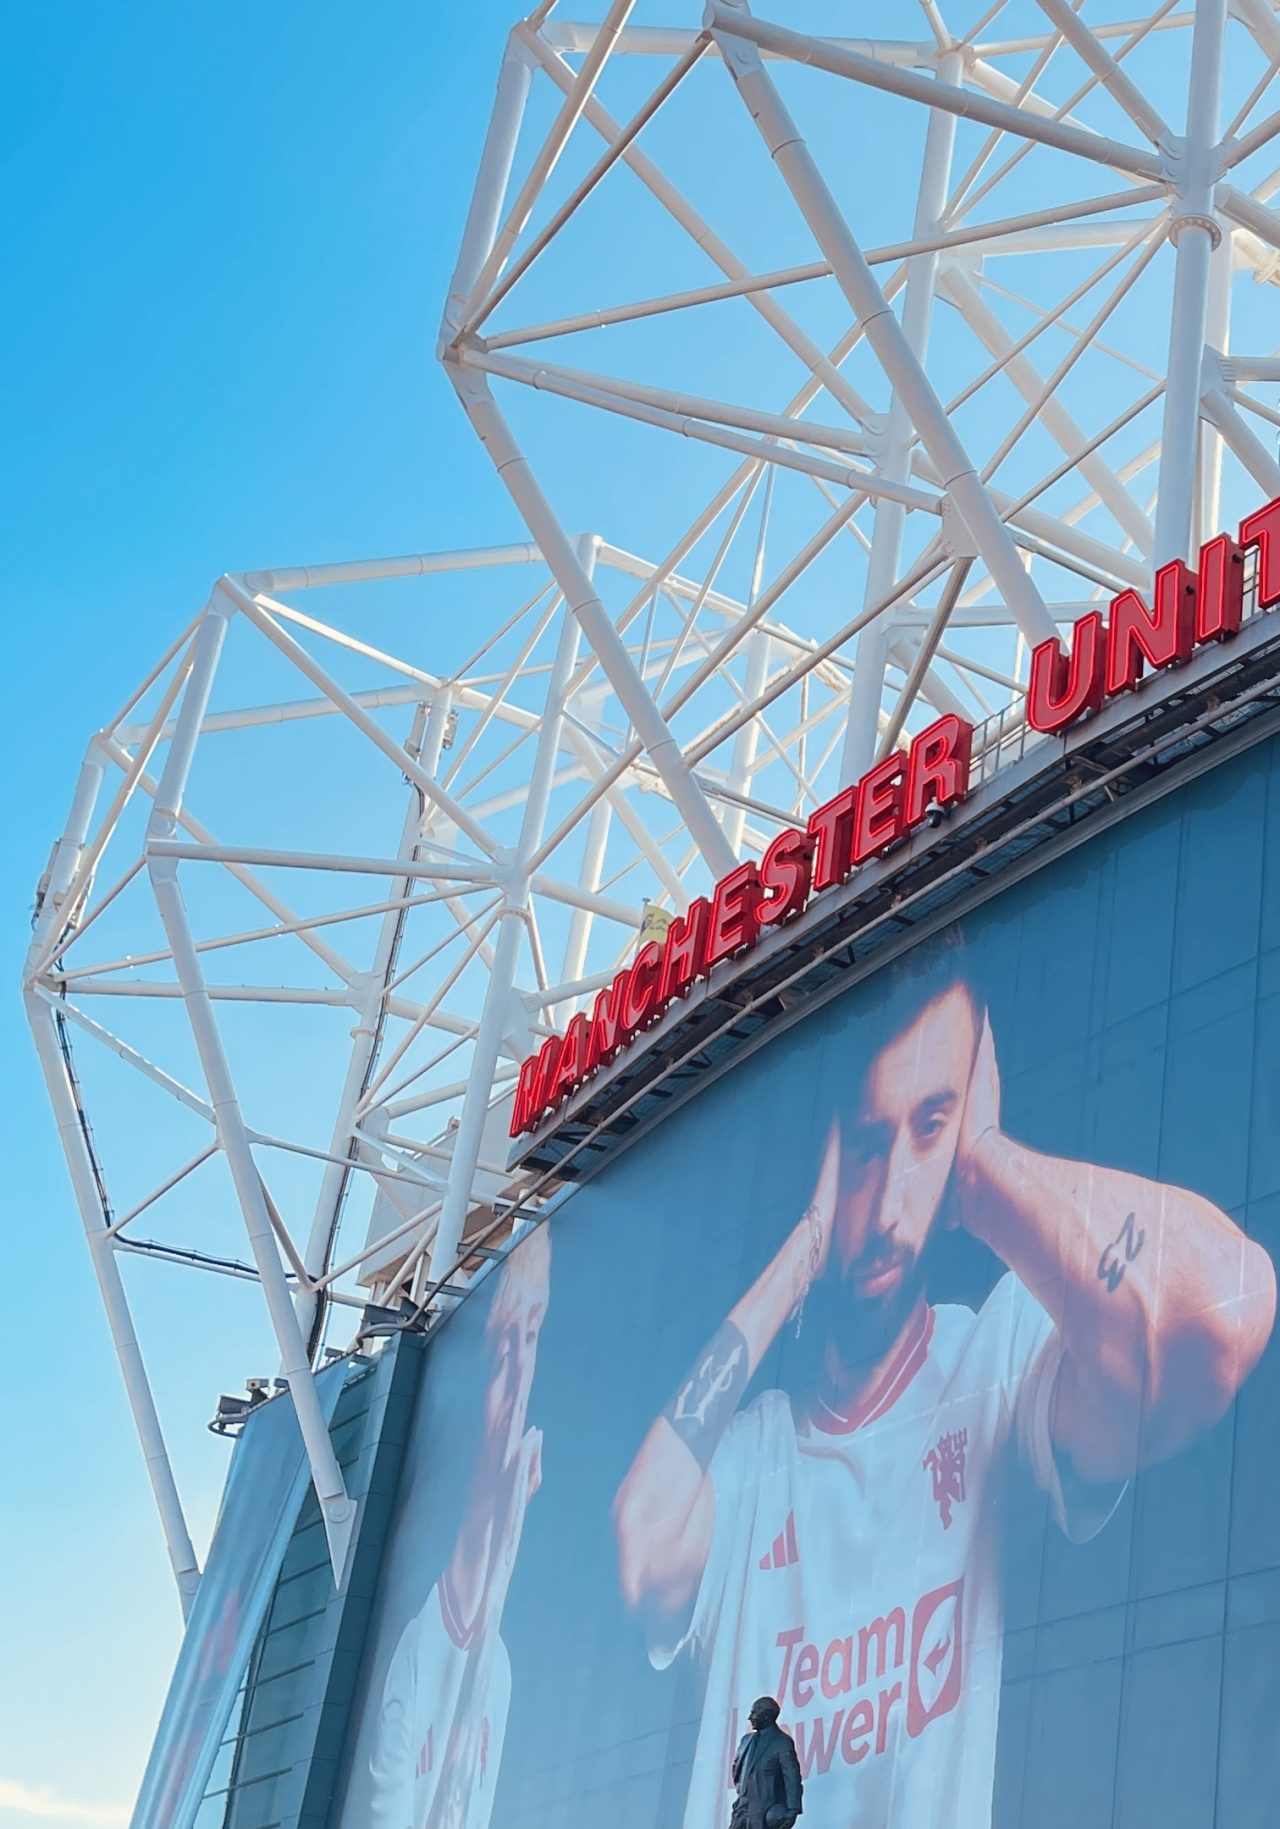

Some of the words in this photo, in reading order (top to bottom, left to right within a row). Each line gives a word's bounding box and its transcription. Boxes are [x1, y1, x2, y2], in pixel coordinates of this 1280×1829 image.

[509, 713, 973, 1138] MANCHESTER
[775, 1606, 905, 1708] Team
[727, 1681, 902, 1790] wer
